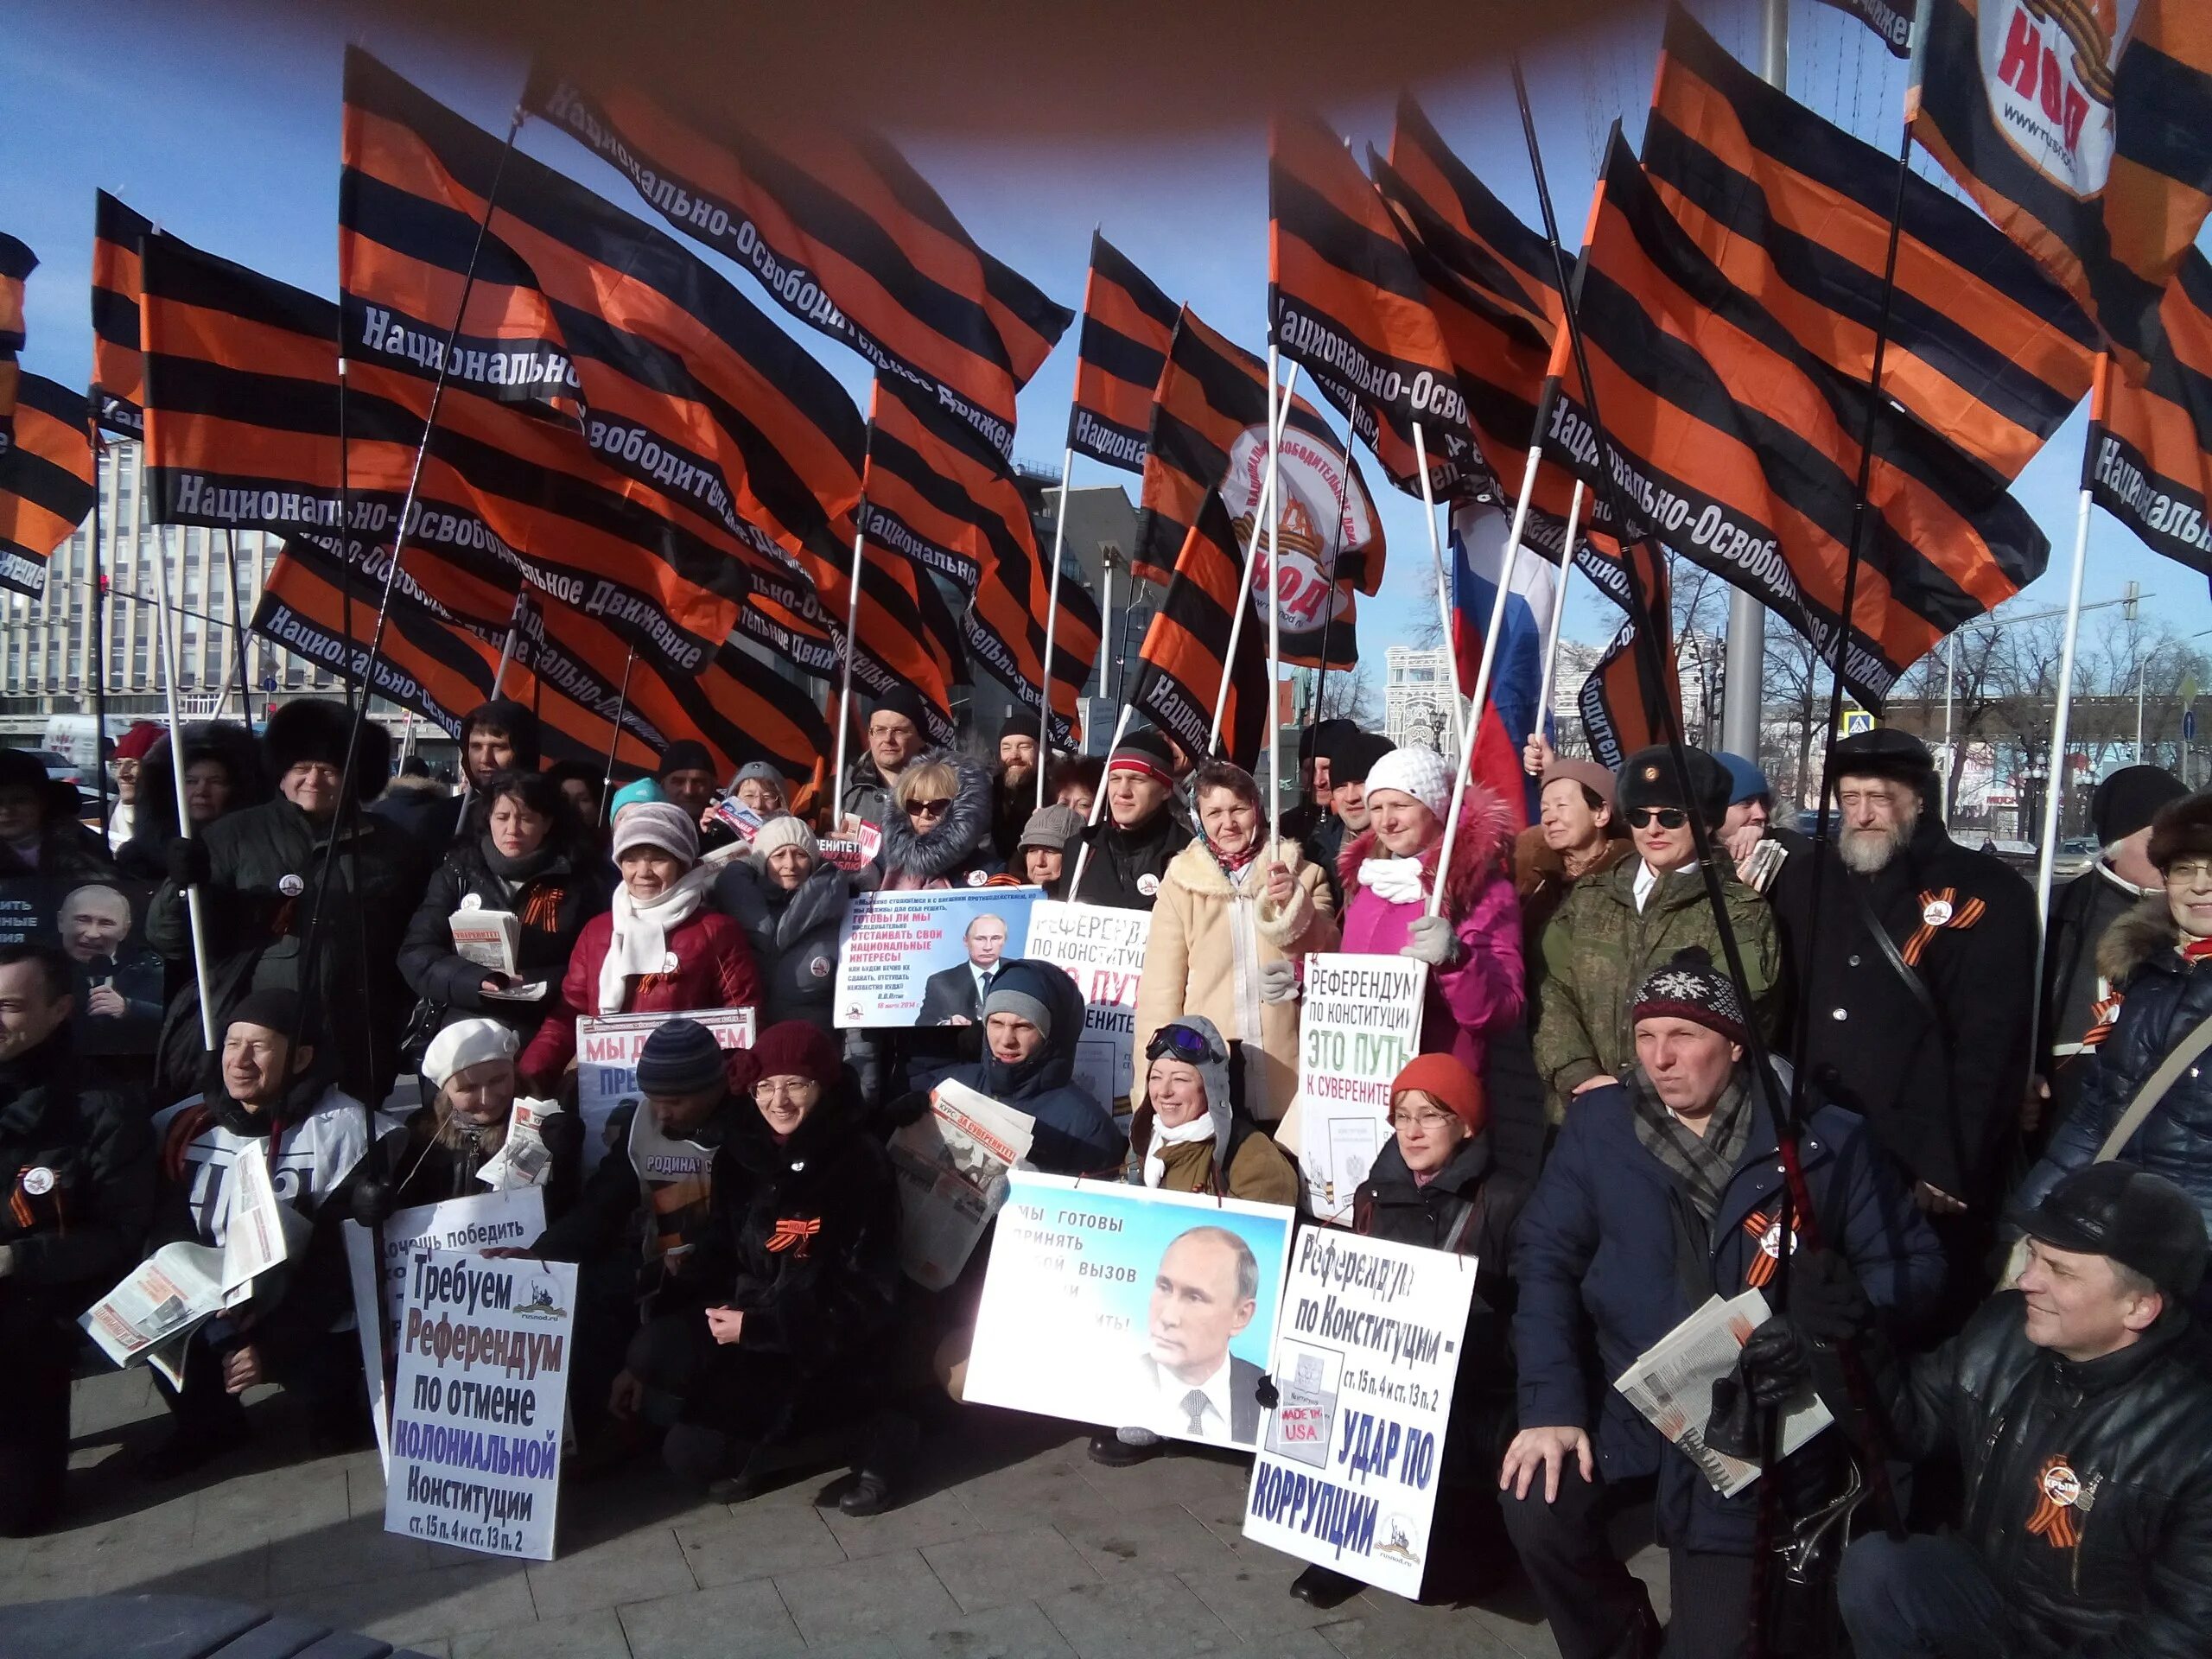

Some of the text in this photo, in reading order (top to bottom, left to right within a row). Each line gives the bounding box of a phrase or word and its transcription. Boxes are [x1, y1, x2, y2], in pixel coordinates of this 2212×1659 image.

[1997, 6, 2089, 155] НОД
[585, 580, 702, 669] Движение
[853, 912, 931, 924] ГОТОВЫ ЛИ МЫ
[850, 941, 931, 951] НАЦИОНАЛЬНЫЕ
[851, 930, 942, 941] ОТСТАИВАТЬ СВОИ
[1032, 938, 1052, 957] ПО
[849, 953, 900, 963] ИНТЕРЕСЫ
[1309, 1001, 1324, 1022] ПО
[587, 1035, 625, 1062] МЫ
[1307, 1028, 1345, 1071] ЭТО
[1306, 1074, 1314, 1096] К
[957, 1115, 969, 1126] ЗА
[447, 1221, 524, 1248] победить
[1058, 1211, 1124, 1233] ГОТОВЫ
[414, 1253, 513, 1316] Требуем
[1078, 1262, 1137, 1283] ВЫЗОВ
[405, 1306, 564, 1381] Референдум
[1295, 1298, 1319, 1333] по
[1319, 1294, 1442, 1370] Конституции
[413, 1374, 537, 1427] по отмене
[1343, 1370, 1355, 1390] ст.
[1358, 1368, 1370, 1394] 15
[1379, 1375, 1386, 1398] 4
[1409, 1382, 1420, 1408] 13
[1421, 1388, 1429, 1410] п.
[1430, 1389, 1439, 1413] 2
[1282, 1408, 1307, 1421] MADE
[1285, 1424, 1318, 1441] USA
[394, 1419, 557, 1481] КОЛОНИАЛЬНОЙ
[1338, 1408, 1435, 1491] УДАР ПО
[406, 1465, 534, 1528] Конституции
[1250, 1461, 1380, 1561] КОРРУПЦИИ
[409, 1516, 423, 1535] ст.
[426, 1514, 438, 1538] 15
[439, 1522, 448, 1541] п.
[451, 1519, 460, 1542] 4
[469, 1529, 484, 1548] ст.
[486, 1525, 499, 1550] 13
[500, 1531, 512, 1552] п.
[515, 1529, 524, 1553] 2
